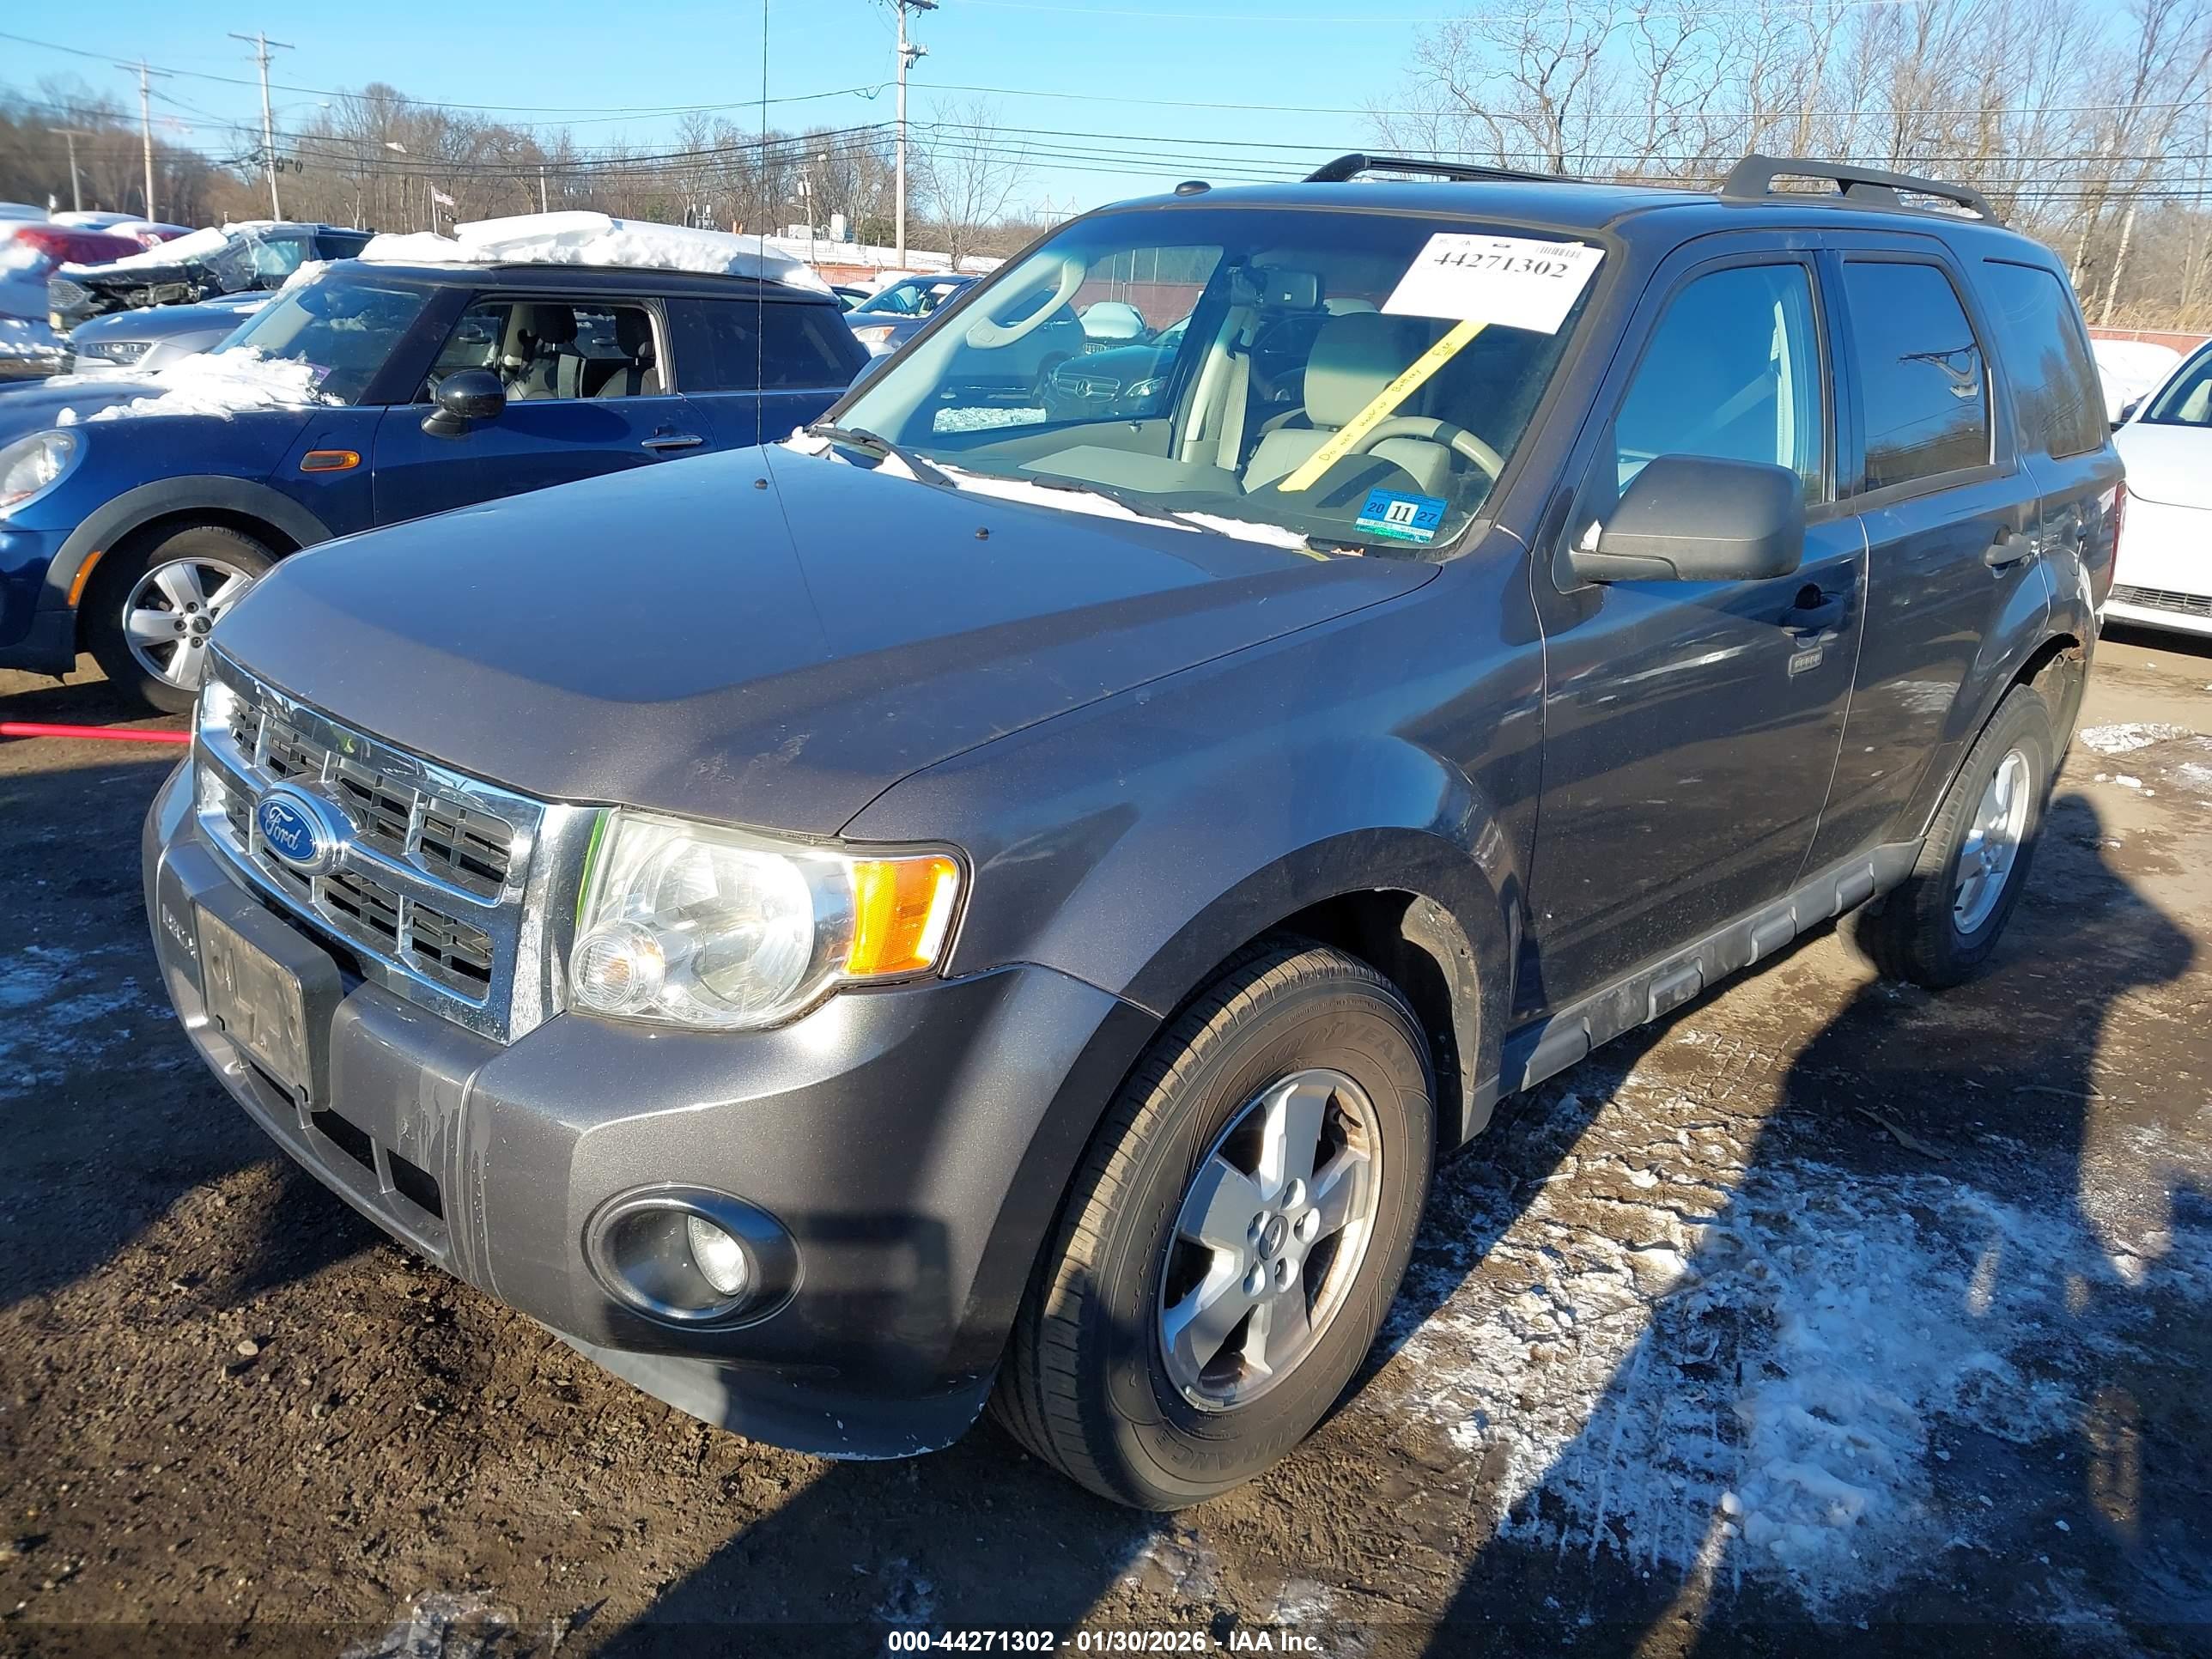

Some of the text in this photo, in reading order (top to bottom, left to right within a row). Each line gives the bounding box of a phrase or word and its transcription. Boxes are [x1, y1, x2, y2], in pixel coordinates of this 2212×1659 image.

[1433, 251, 1569, 278] 44271302
[1366, 501, 1438, 523] 20 11 27
[264, 805, 301, 850] Ford
